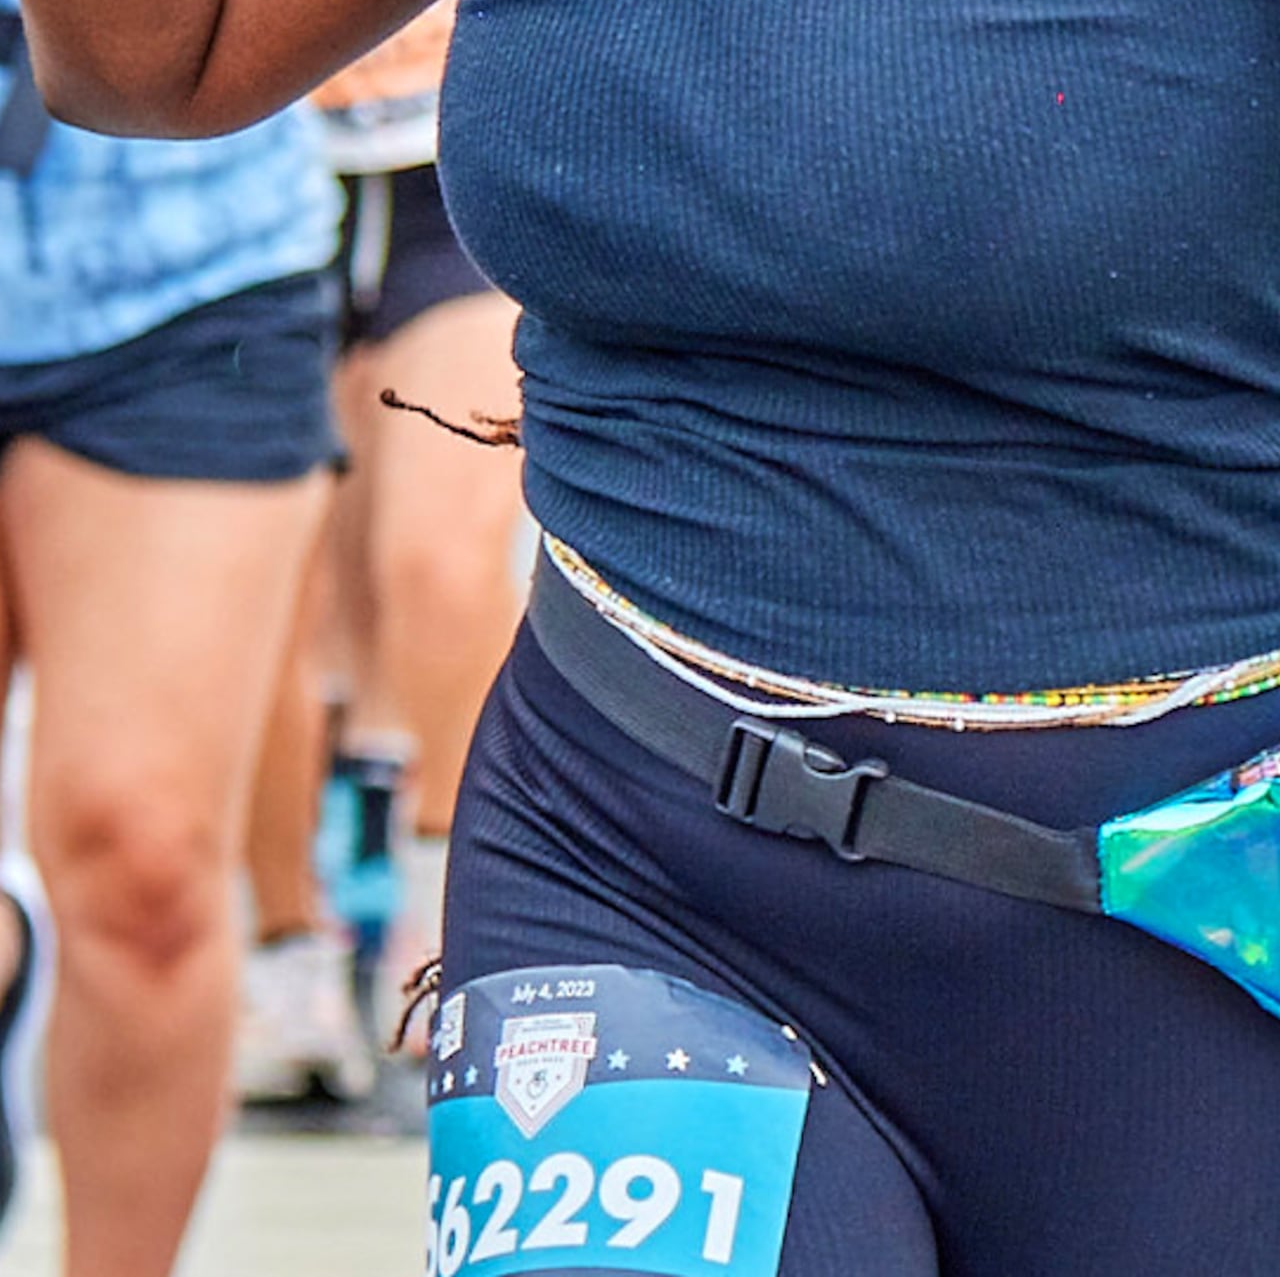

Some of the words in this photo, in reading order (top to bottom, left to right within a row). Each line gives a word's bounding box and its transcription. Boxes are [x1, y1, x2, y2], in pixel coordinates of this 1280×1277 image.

[510, 984, 537, 1005] July
[538, 982, 553, 1001] 4,
[556, 980, 595, 997] 2023
[500, 1039, 591, 1059] PEACHTREE
